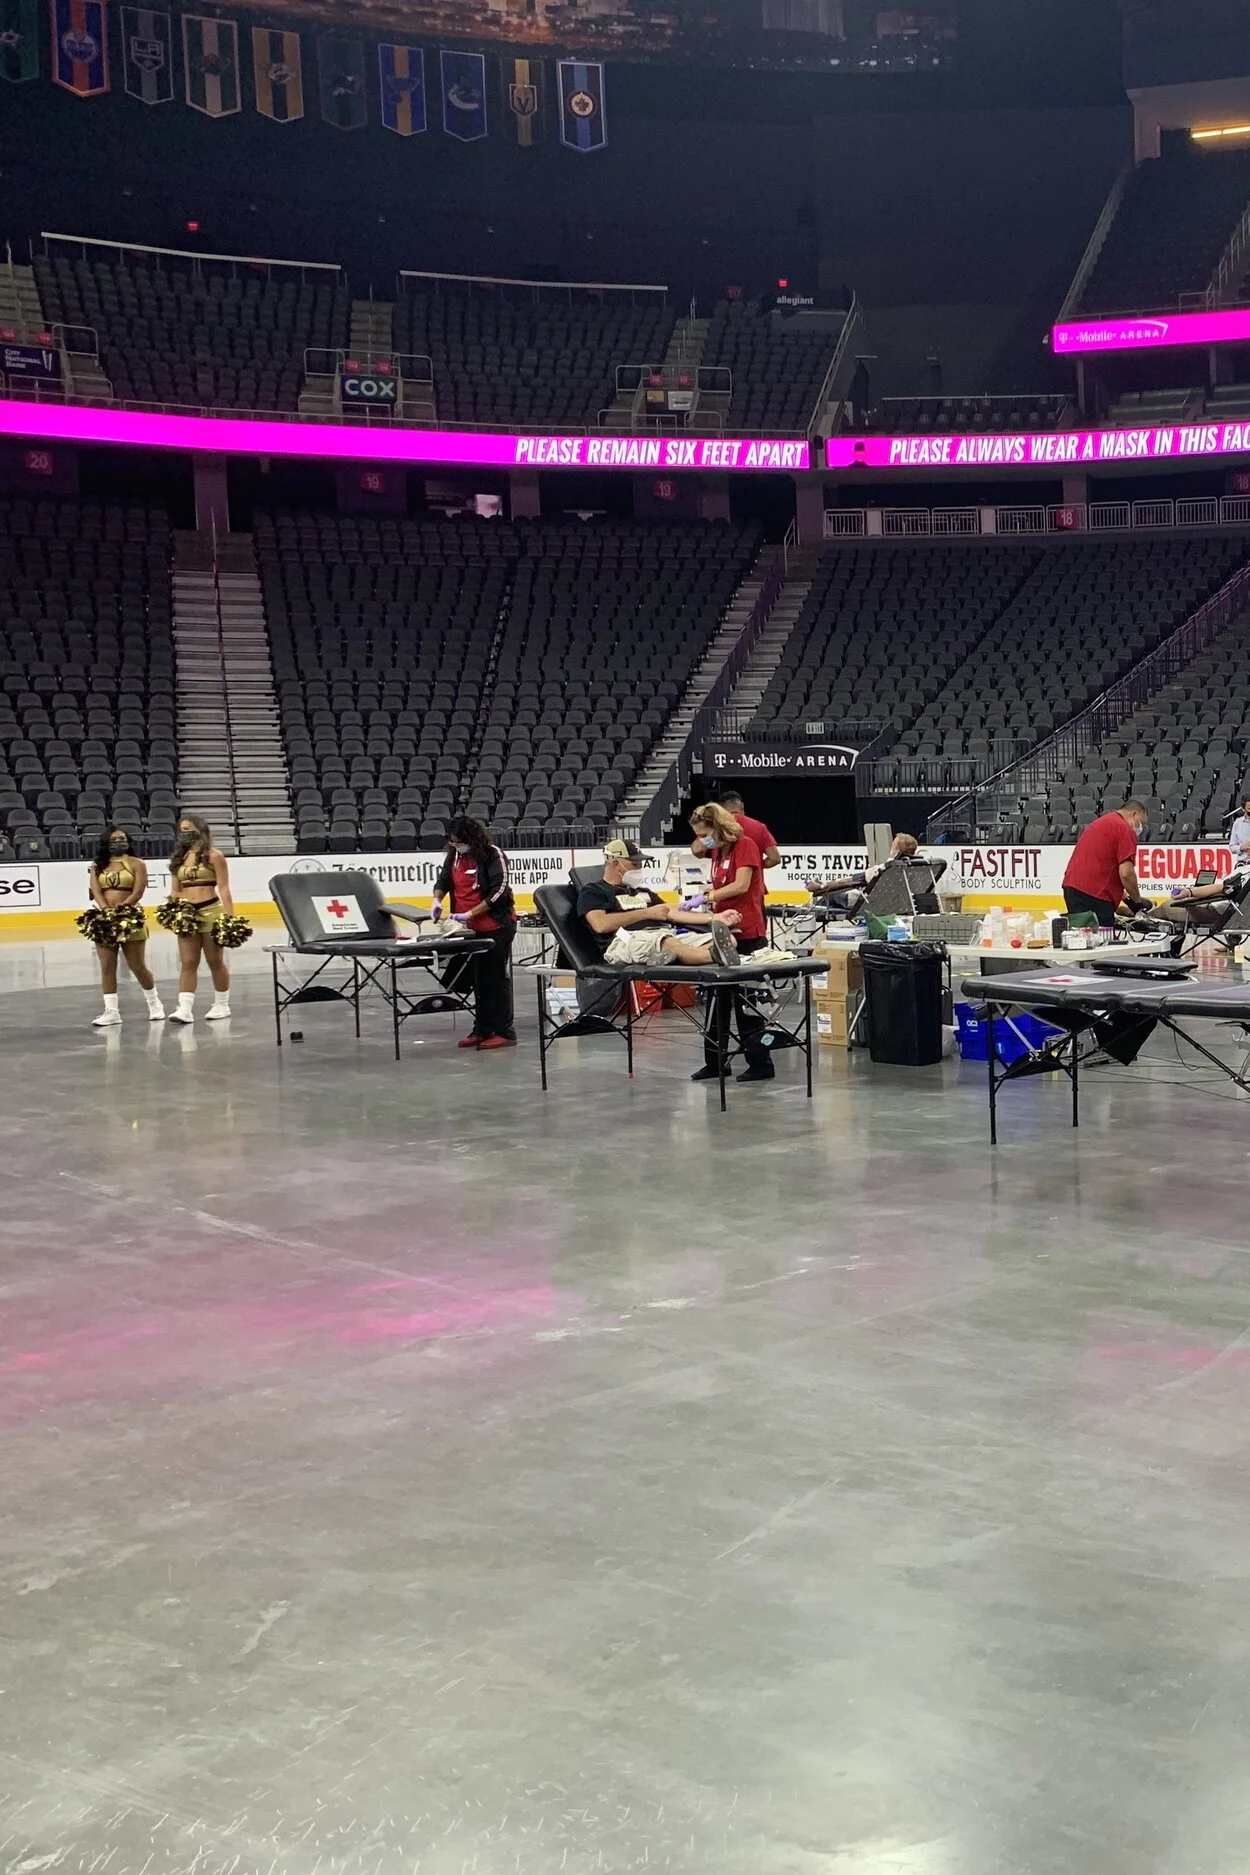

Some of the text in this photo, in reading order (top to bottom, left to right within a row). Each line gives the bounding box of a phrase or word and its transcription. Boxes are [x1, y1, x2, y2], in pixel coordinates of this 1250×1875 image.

[776, 296, 814, 306] allegiant
[1120, 329, 1159, 340] ARENA
[344, 379, 396, 397] COX
[515, 438, 806, 466] PLEASE REMAIN SIX FEET APART
[889, 439, 953, 464] PLEASE
[956, 437, 1025, 463] ALWAYS
[1031, 435, 1080, 460] WEAR
[1081, 434, 1094, 459] A
[1100, 430, 1152, 458] MASK
[1154, 429, 1174, 455] IN
[1178, 426, 1219, 453] THIS
[30, 454, 49, 469] 20
[1239, 475, 1249, 490] 18
[659, 483, 671, 497] 19
[1061, 511, 1073, 526] 18
[795, 755, 848, 766] ARENA
[508, 857, 563, 871] DOWNLOAD
[781, 855, 817, 869] PT'S
[509, 871, 549, 885] THE APP
[787, 873, 823, 881] HOCKEY
[961, 879, 1041, 889] BODY SCULPTING
